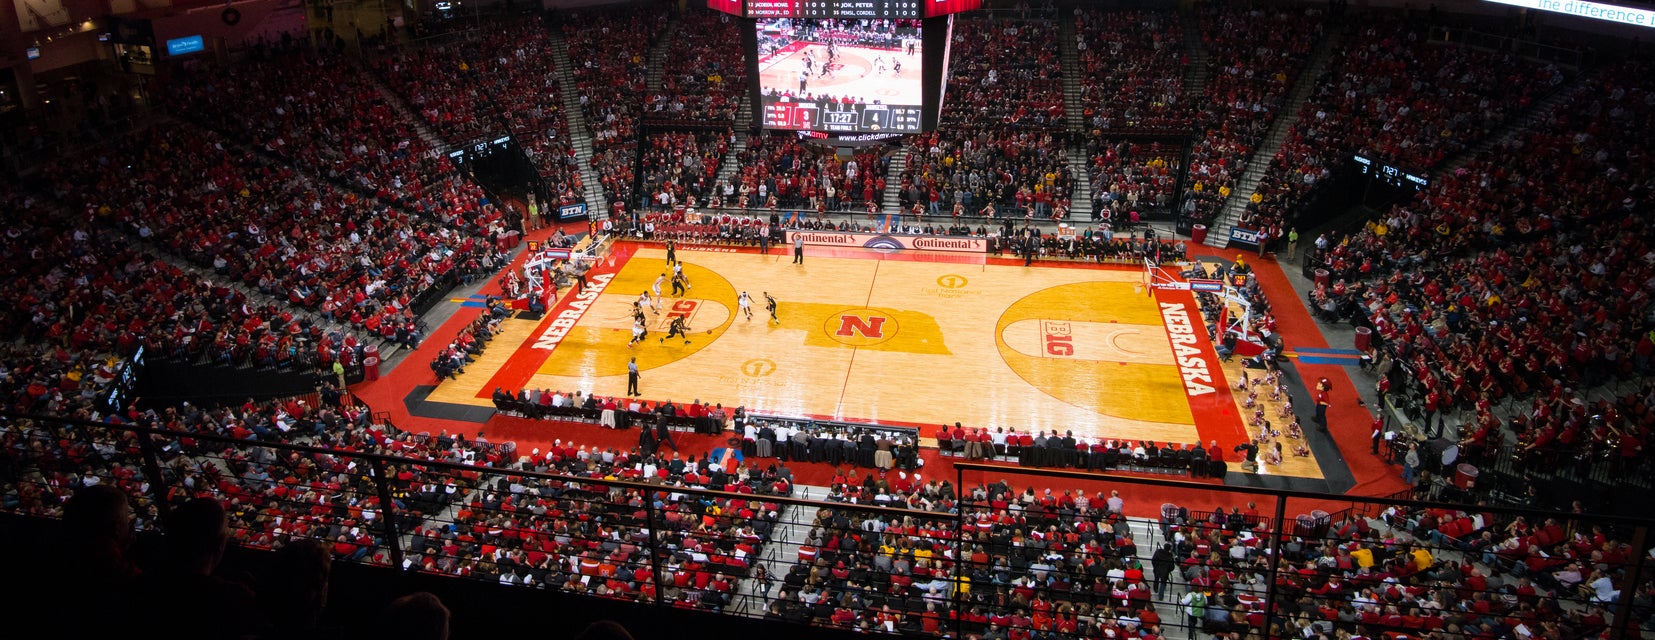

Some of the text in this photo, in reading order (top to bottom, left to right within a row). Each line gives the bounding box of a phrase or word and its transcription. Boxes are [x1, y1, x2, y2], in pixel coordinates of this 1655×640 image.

[1564, 0, 1645, 24] difference
[803, 110, 809, 120] 3
[830, 113, 852, 123] 17:27
[872, 113, 879, 122] 4
[1362, 165, 1368, 174] 3
[561, 206, 582, 216] BTN
[1232, 230, 1257, 242] BTN
[912, 237, 971, 249] Continental
[531, 273, 616, 350] NEBRASKA
[835, 314, 887, 339] N
[1160, 302, 1216, 396] NEBRASKA
